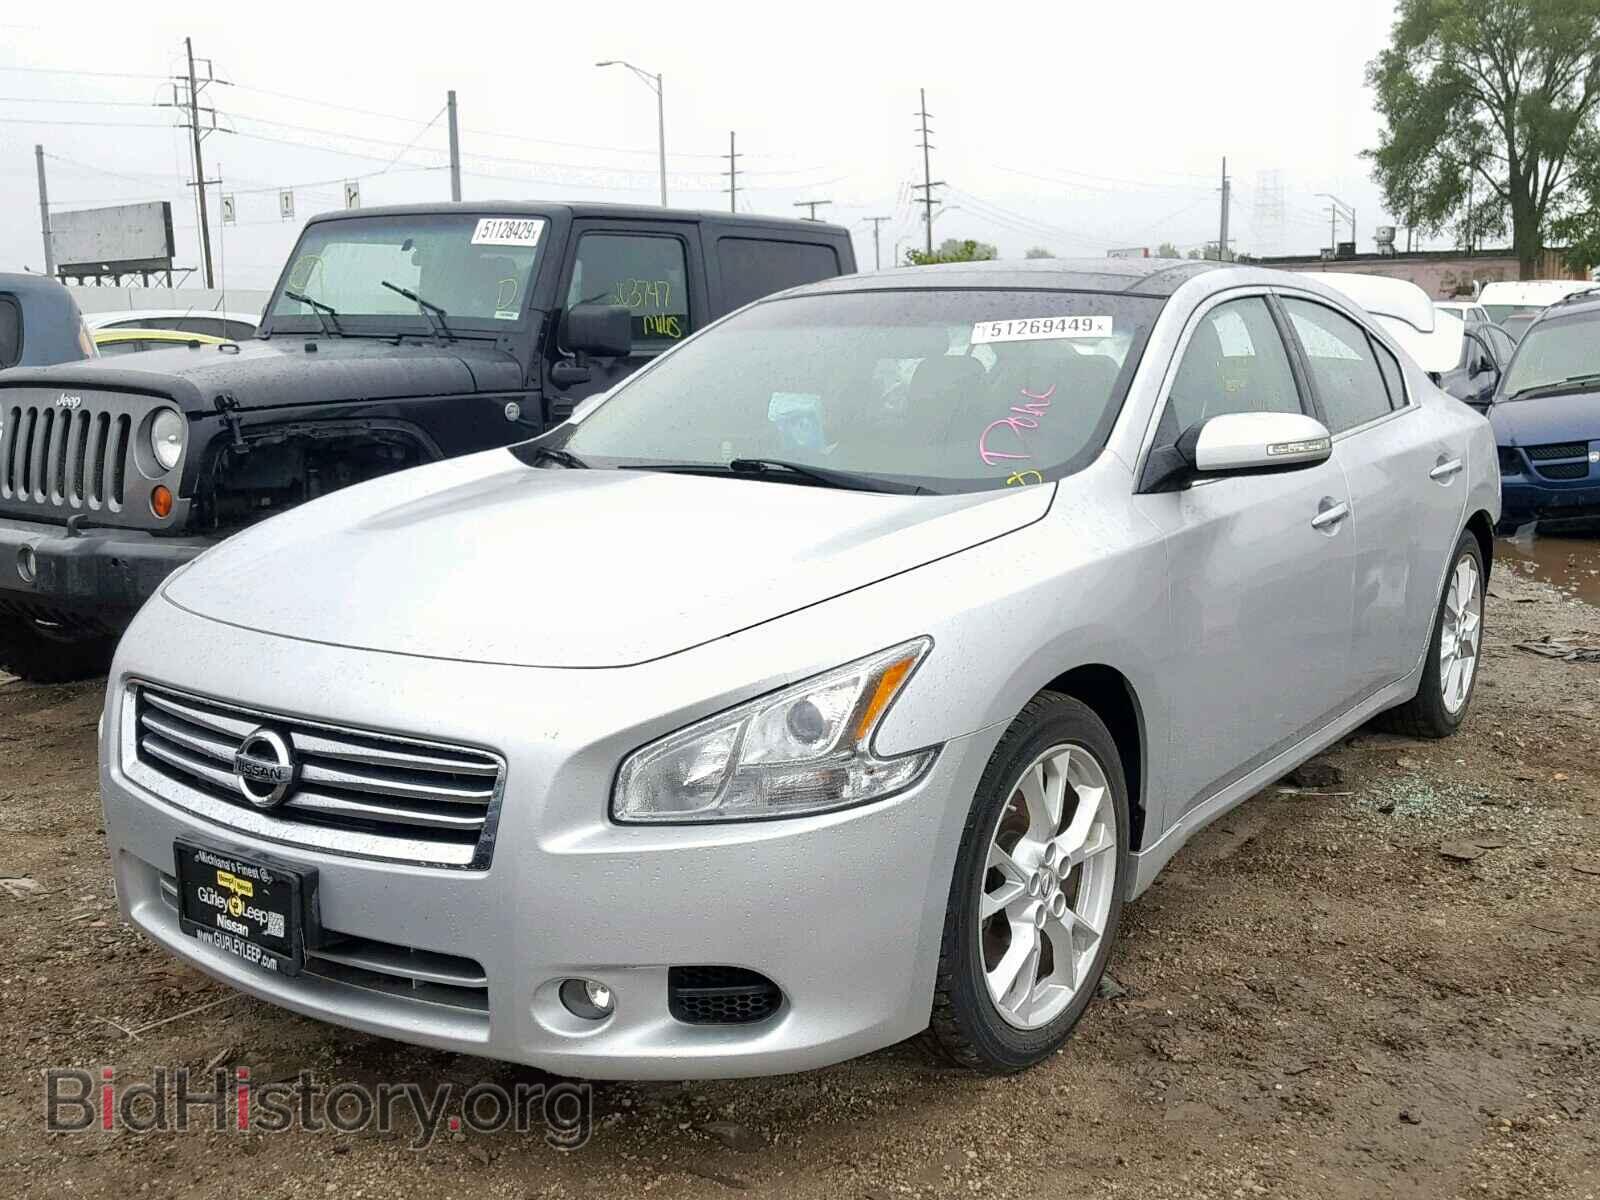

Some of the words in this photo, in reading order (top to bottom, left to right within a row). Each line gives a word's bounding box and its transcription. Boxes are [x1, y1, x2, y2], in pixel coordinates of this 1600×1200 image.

[56, 393, 81, 409] Jeep
[232, 756, 282, 780] NISSAN
[216, 913, 249, 938] Nissan
[242, 901, 268, 926] Leep
